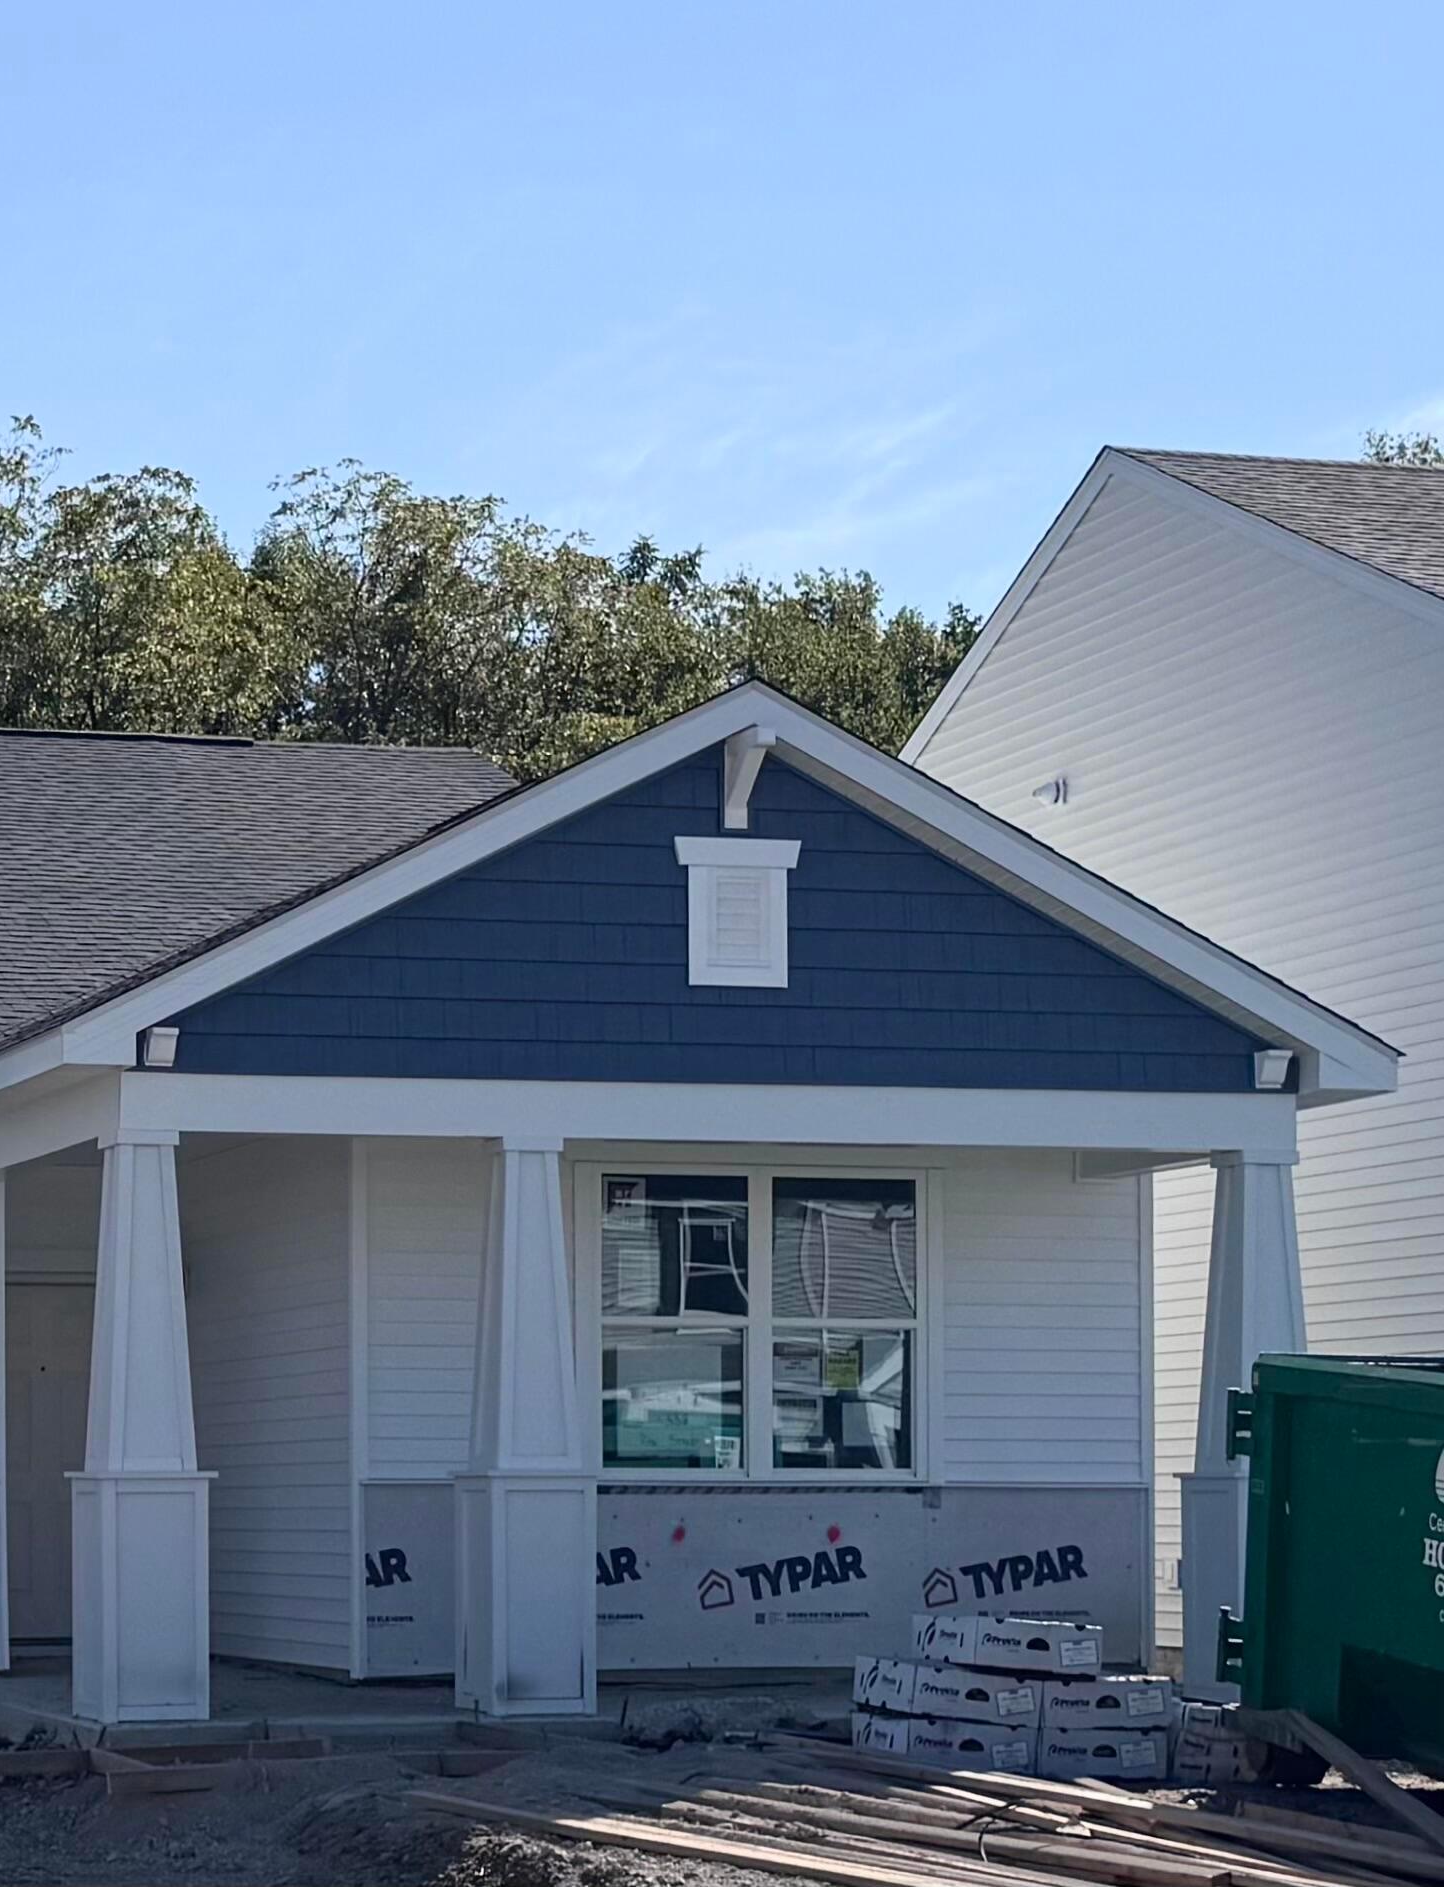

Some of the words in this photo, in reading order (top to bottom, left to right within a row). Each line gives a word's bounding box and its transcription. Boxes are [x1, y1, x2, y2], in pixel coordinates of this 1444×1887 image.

[1428, 1512, 1444, 1533] Ce
[735, 1546, 867, 1600] TYPAR
[959, 1545, 1088, 1599] TYPAR
